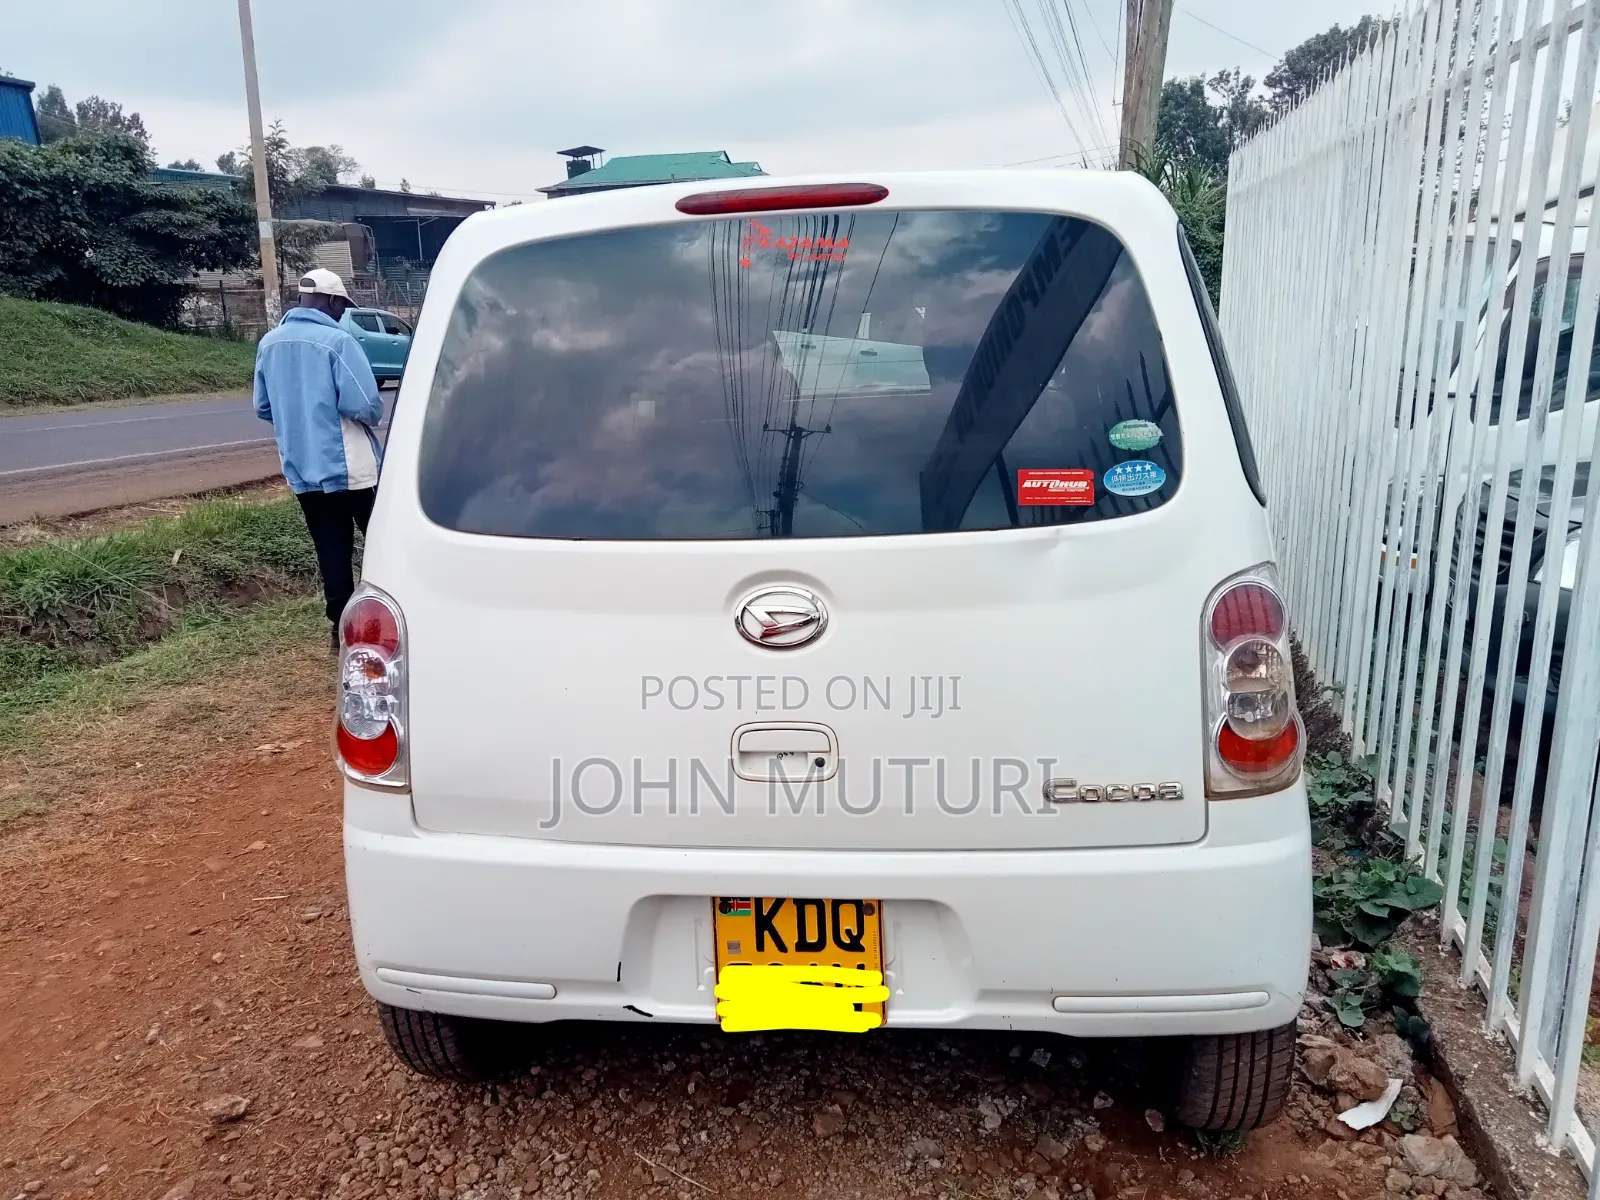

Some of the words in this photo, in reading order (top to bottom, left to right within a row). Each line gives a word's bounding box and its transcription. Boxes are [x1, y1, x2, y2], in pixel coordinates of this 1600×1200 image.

[1022, 479, 1089, 489] AUTOHUB
[1043, 778, 1184, 803] Cocoa
[754, 897, 866, 953] KDQ
